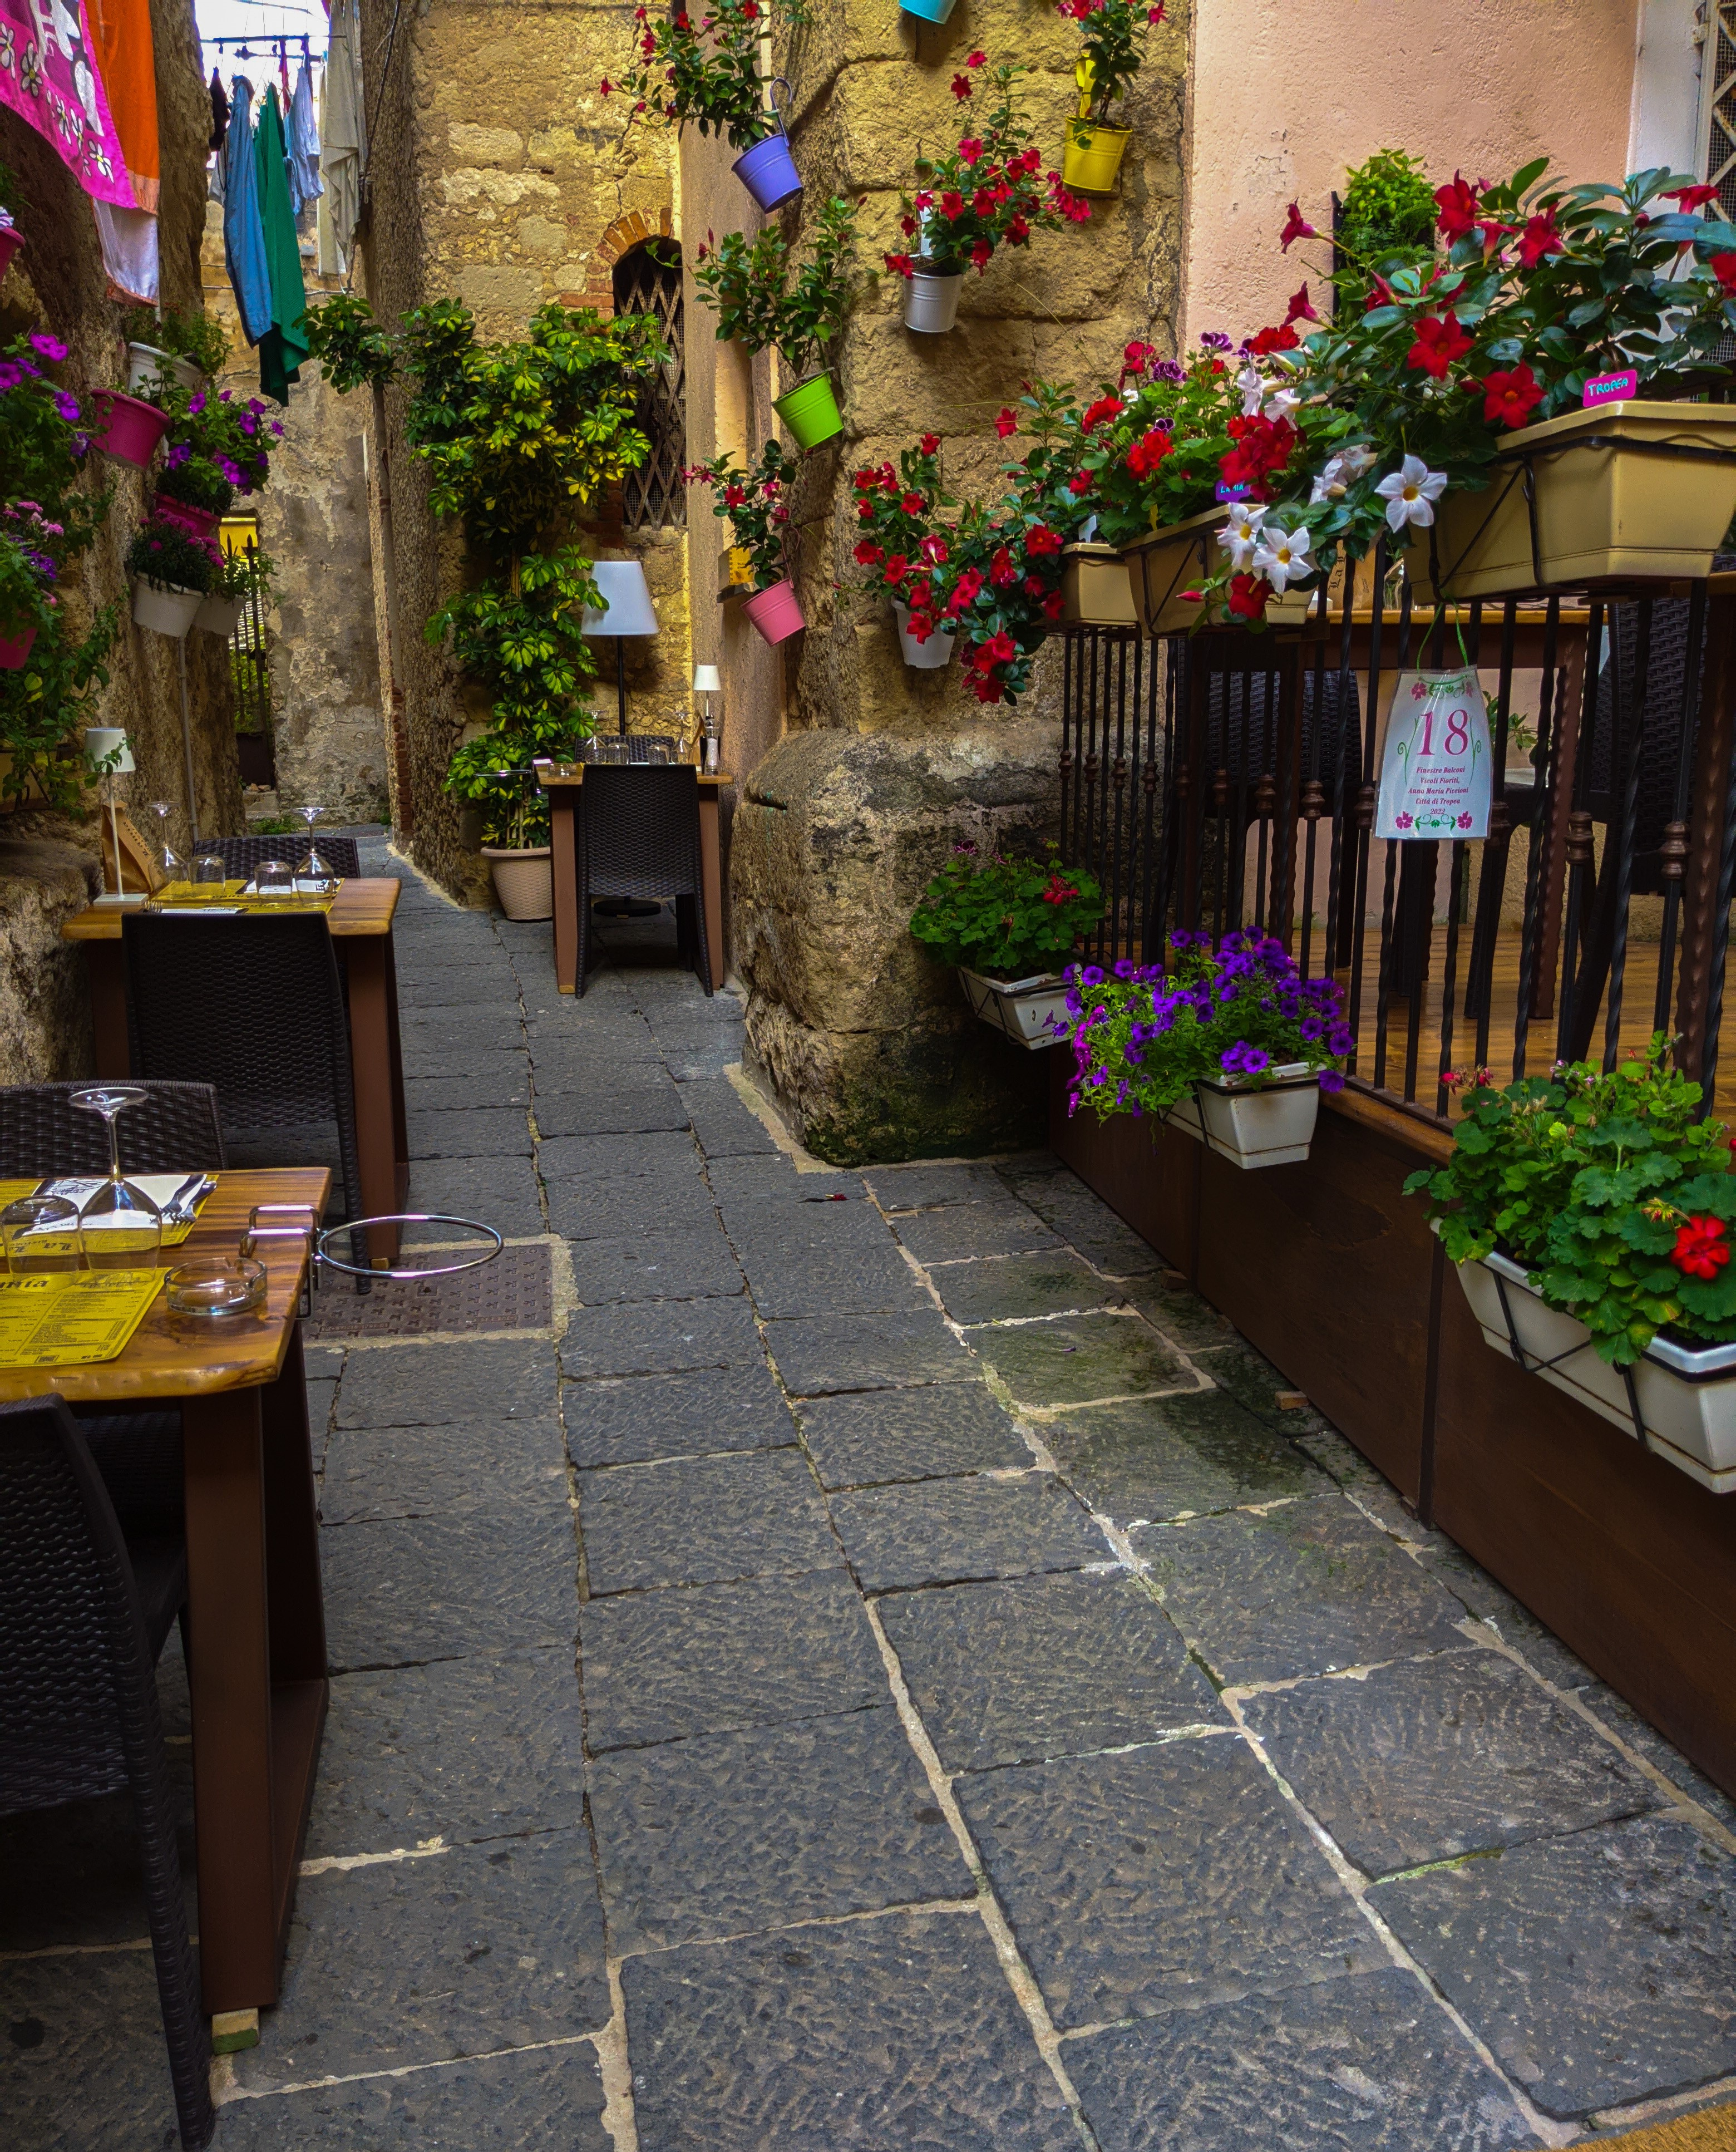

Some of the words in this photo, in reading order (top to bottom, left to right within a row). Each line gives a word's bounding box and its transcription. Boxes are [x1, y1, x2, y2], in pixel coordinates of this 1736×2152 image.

[1587, 377, 1629, 397] TROPEA
[1417, 709, 1468, 755] 18
[1440, 797, 1461, 806] Tropea
